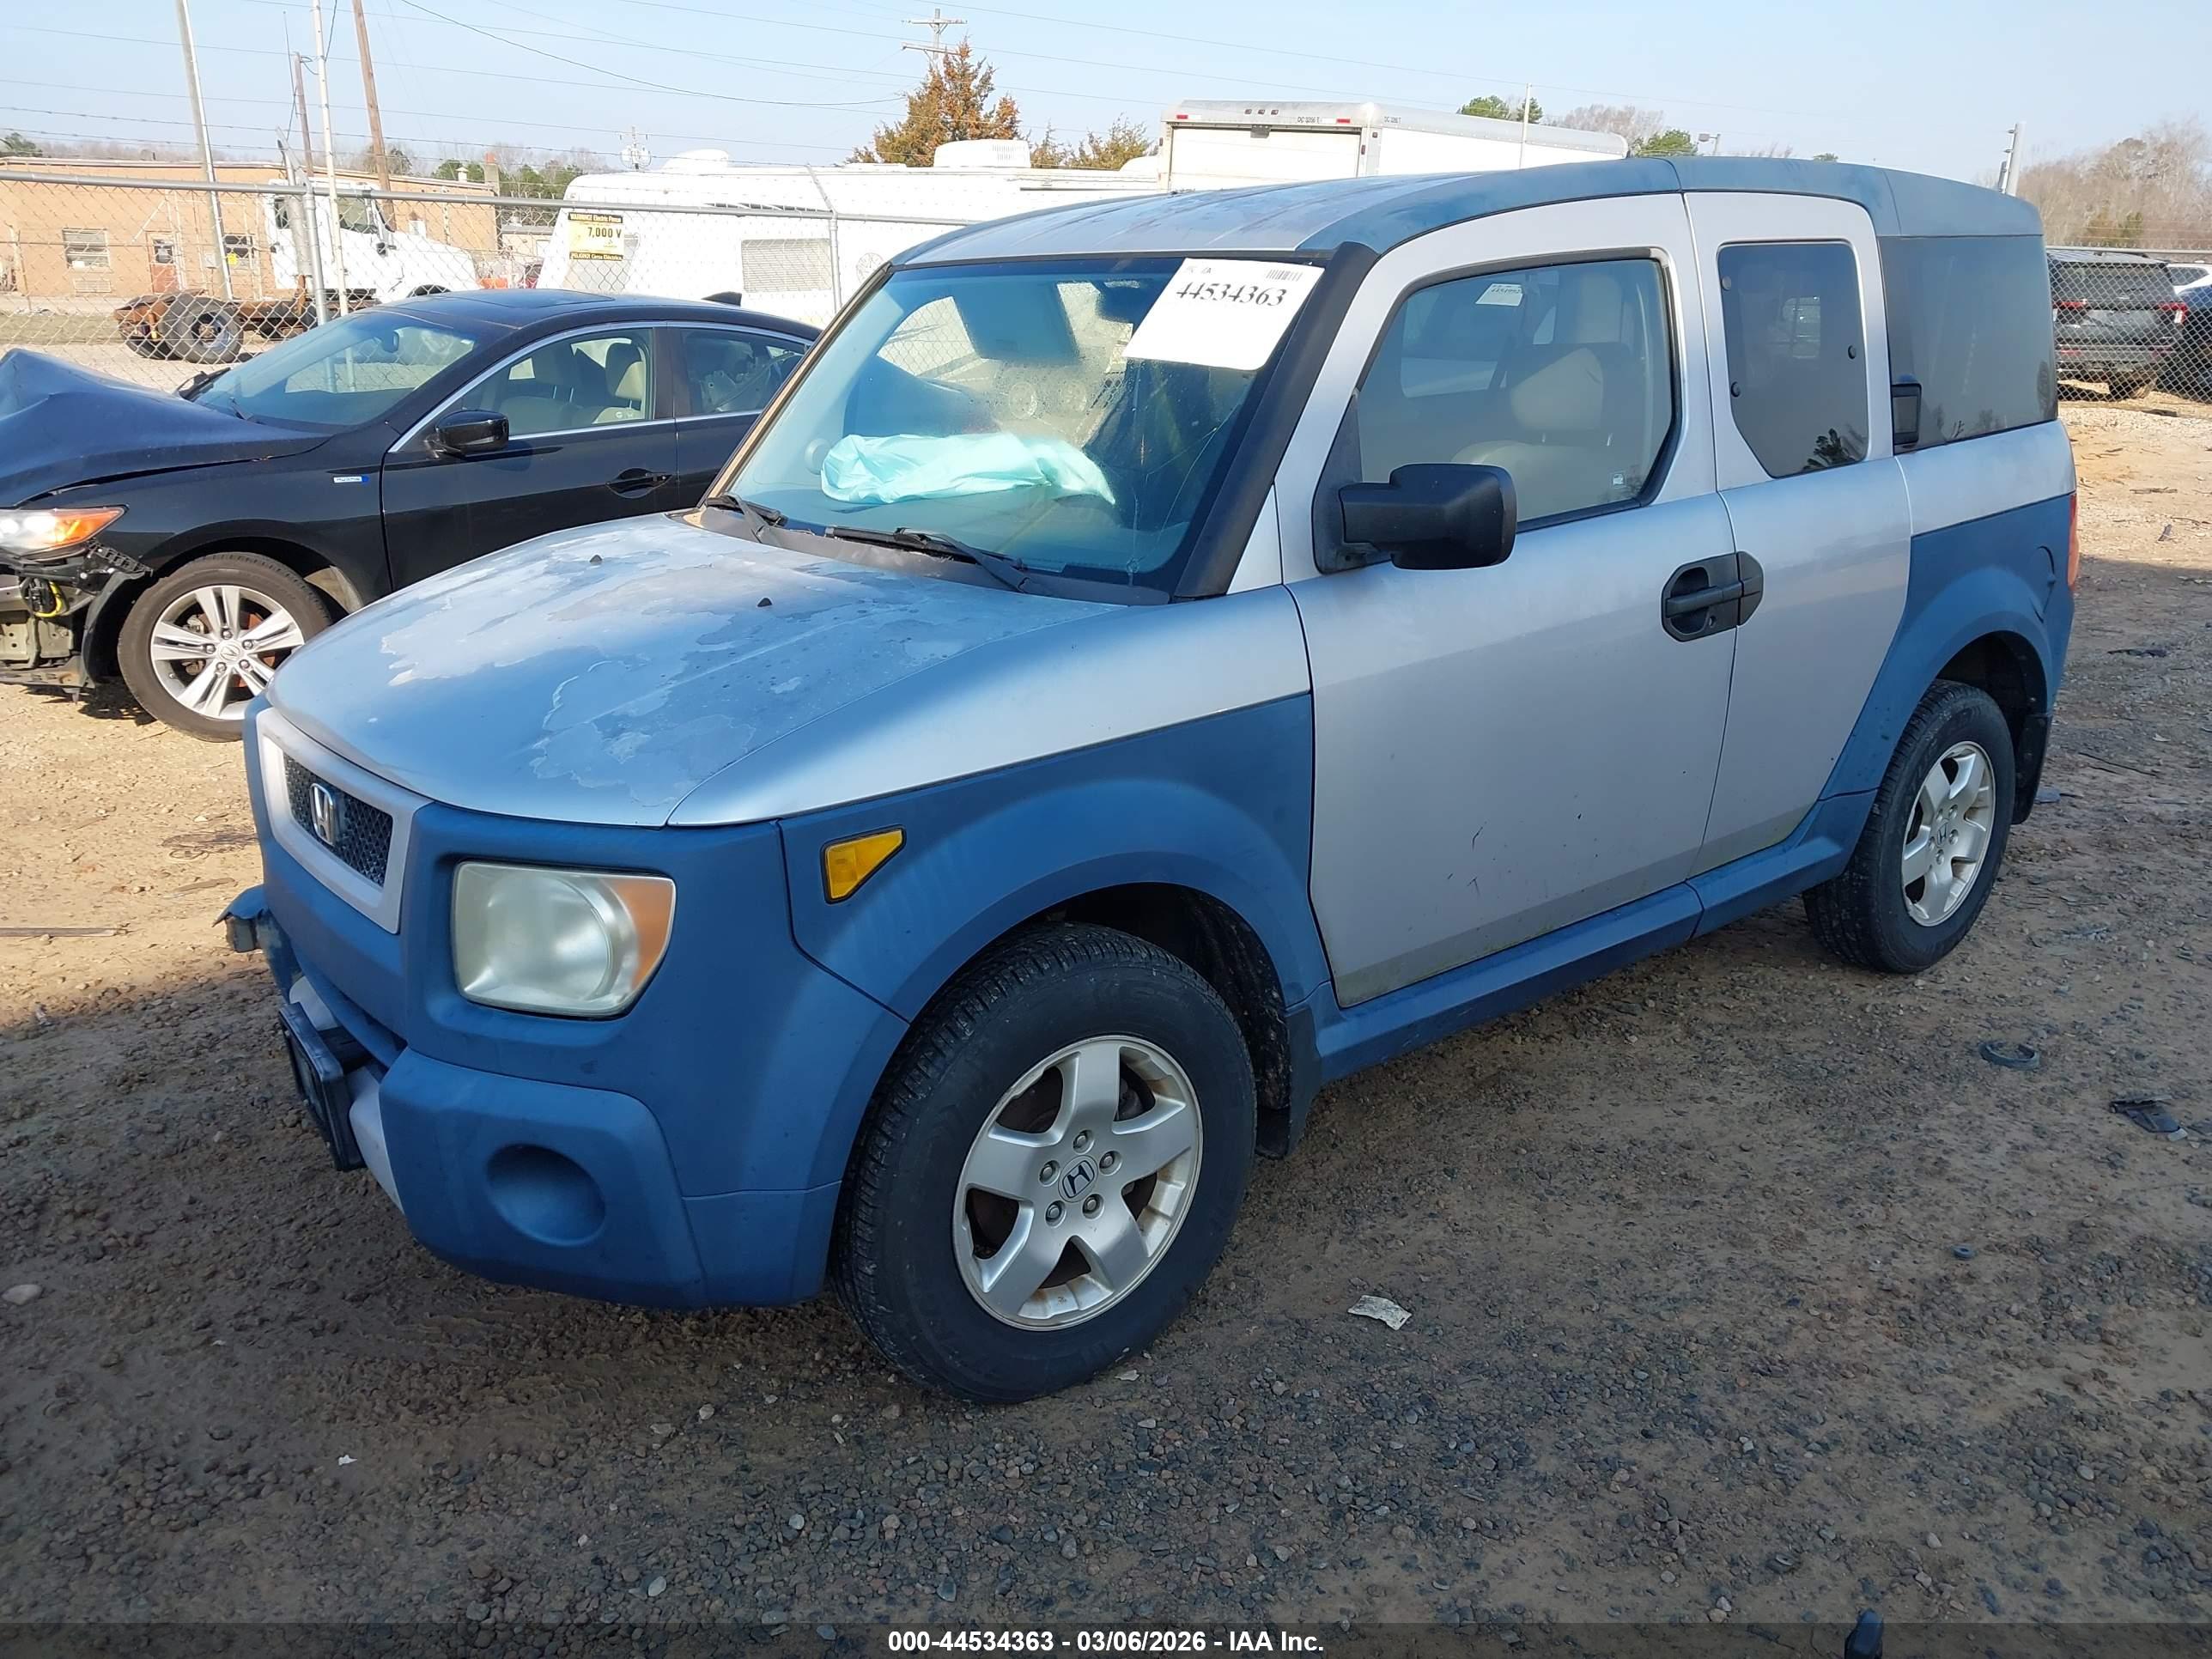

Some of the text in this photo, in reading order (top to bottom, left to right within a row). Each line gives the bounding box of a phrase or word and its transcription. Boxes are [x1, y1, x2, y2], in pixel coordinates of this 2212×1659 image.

[587, 226, 622, 239] 7,000 V
[1176, 282, 1287, 307] 44534363
